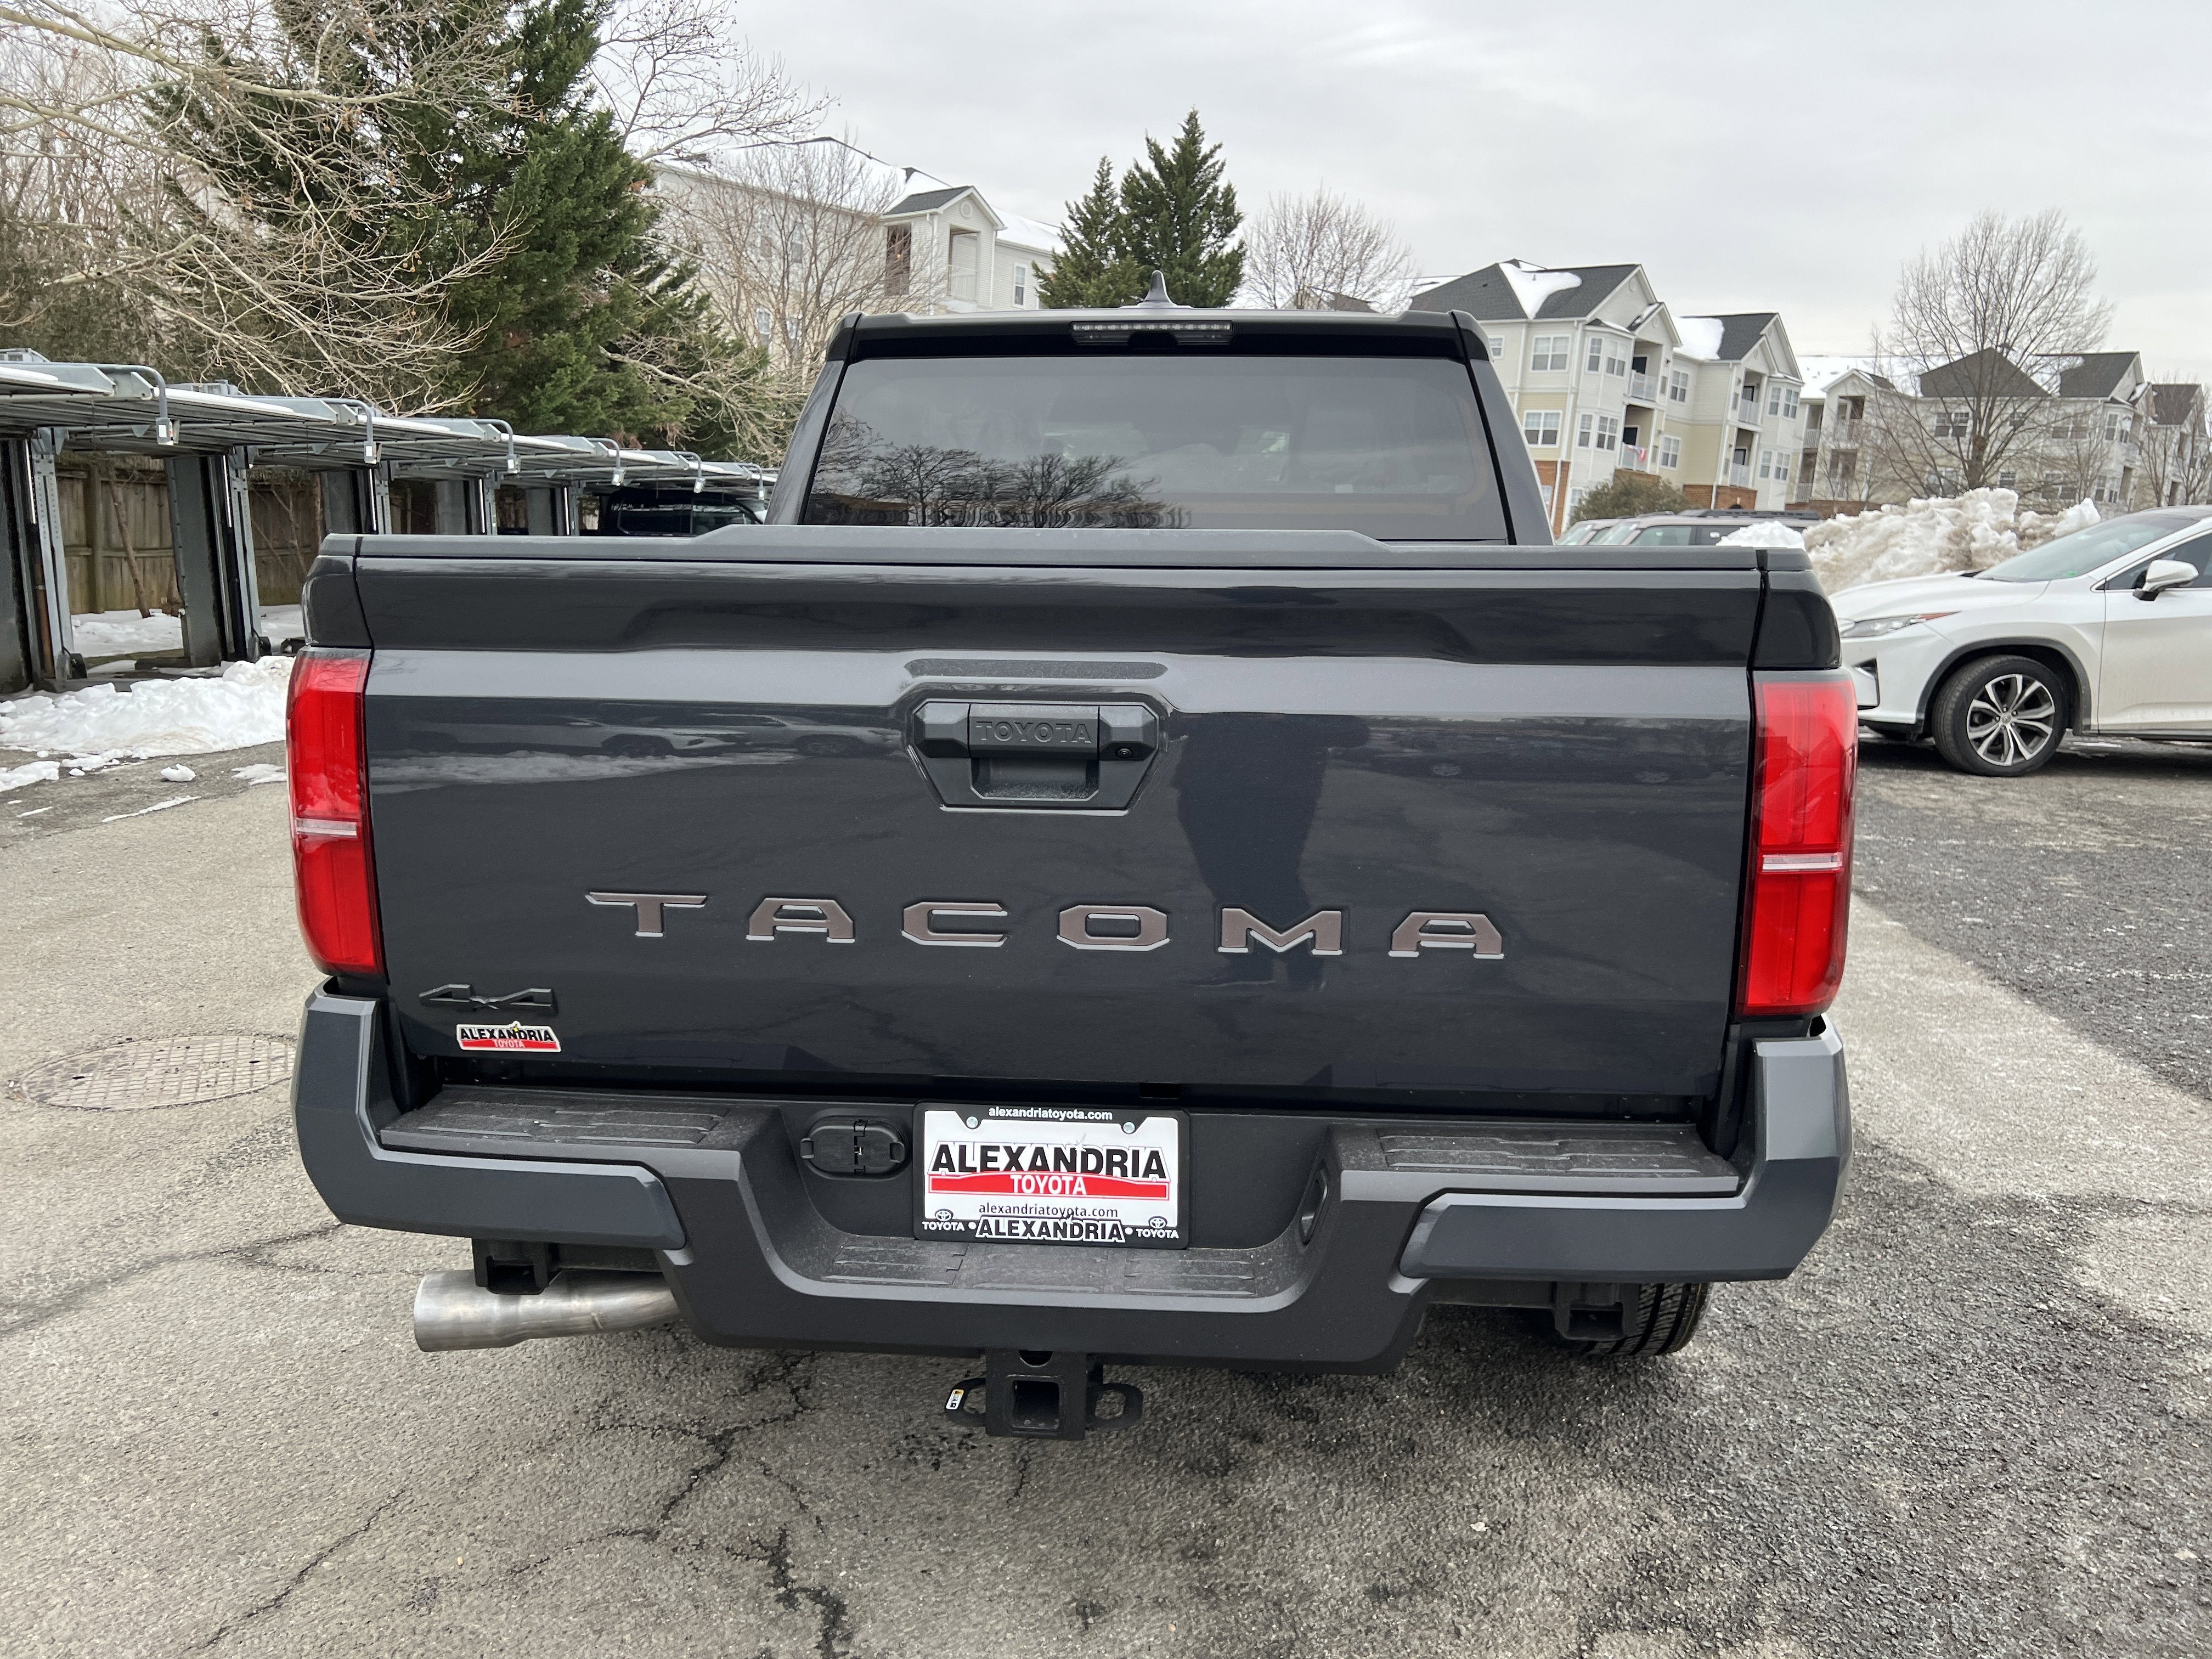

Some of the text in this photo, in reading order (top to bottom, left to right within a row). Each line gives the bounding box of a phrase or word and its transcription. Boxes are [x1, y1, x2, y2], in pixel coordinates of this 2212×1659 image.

[975, 721, 1092, 744] TOYOTA
[585, 892, 1504, 960] TACOMA
[460, 1028, 554, 1042] ALEXANDRIA
[493, 1039, 525, 1048] TOYOTA
[989, 1106, 1113, 1121] alexandriatoyota.com
[931, 1143, 1167, 1179] ALEXANDRIA
[1009, 1174, 1087, 1195] TOYOTA
[979, 1202, 1118, 1218] alexandriatoyota.com
[922, 1218, 1179, 1242] TOYOTA ALEXANDRIA TOYOTA
